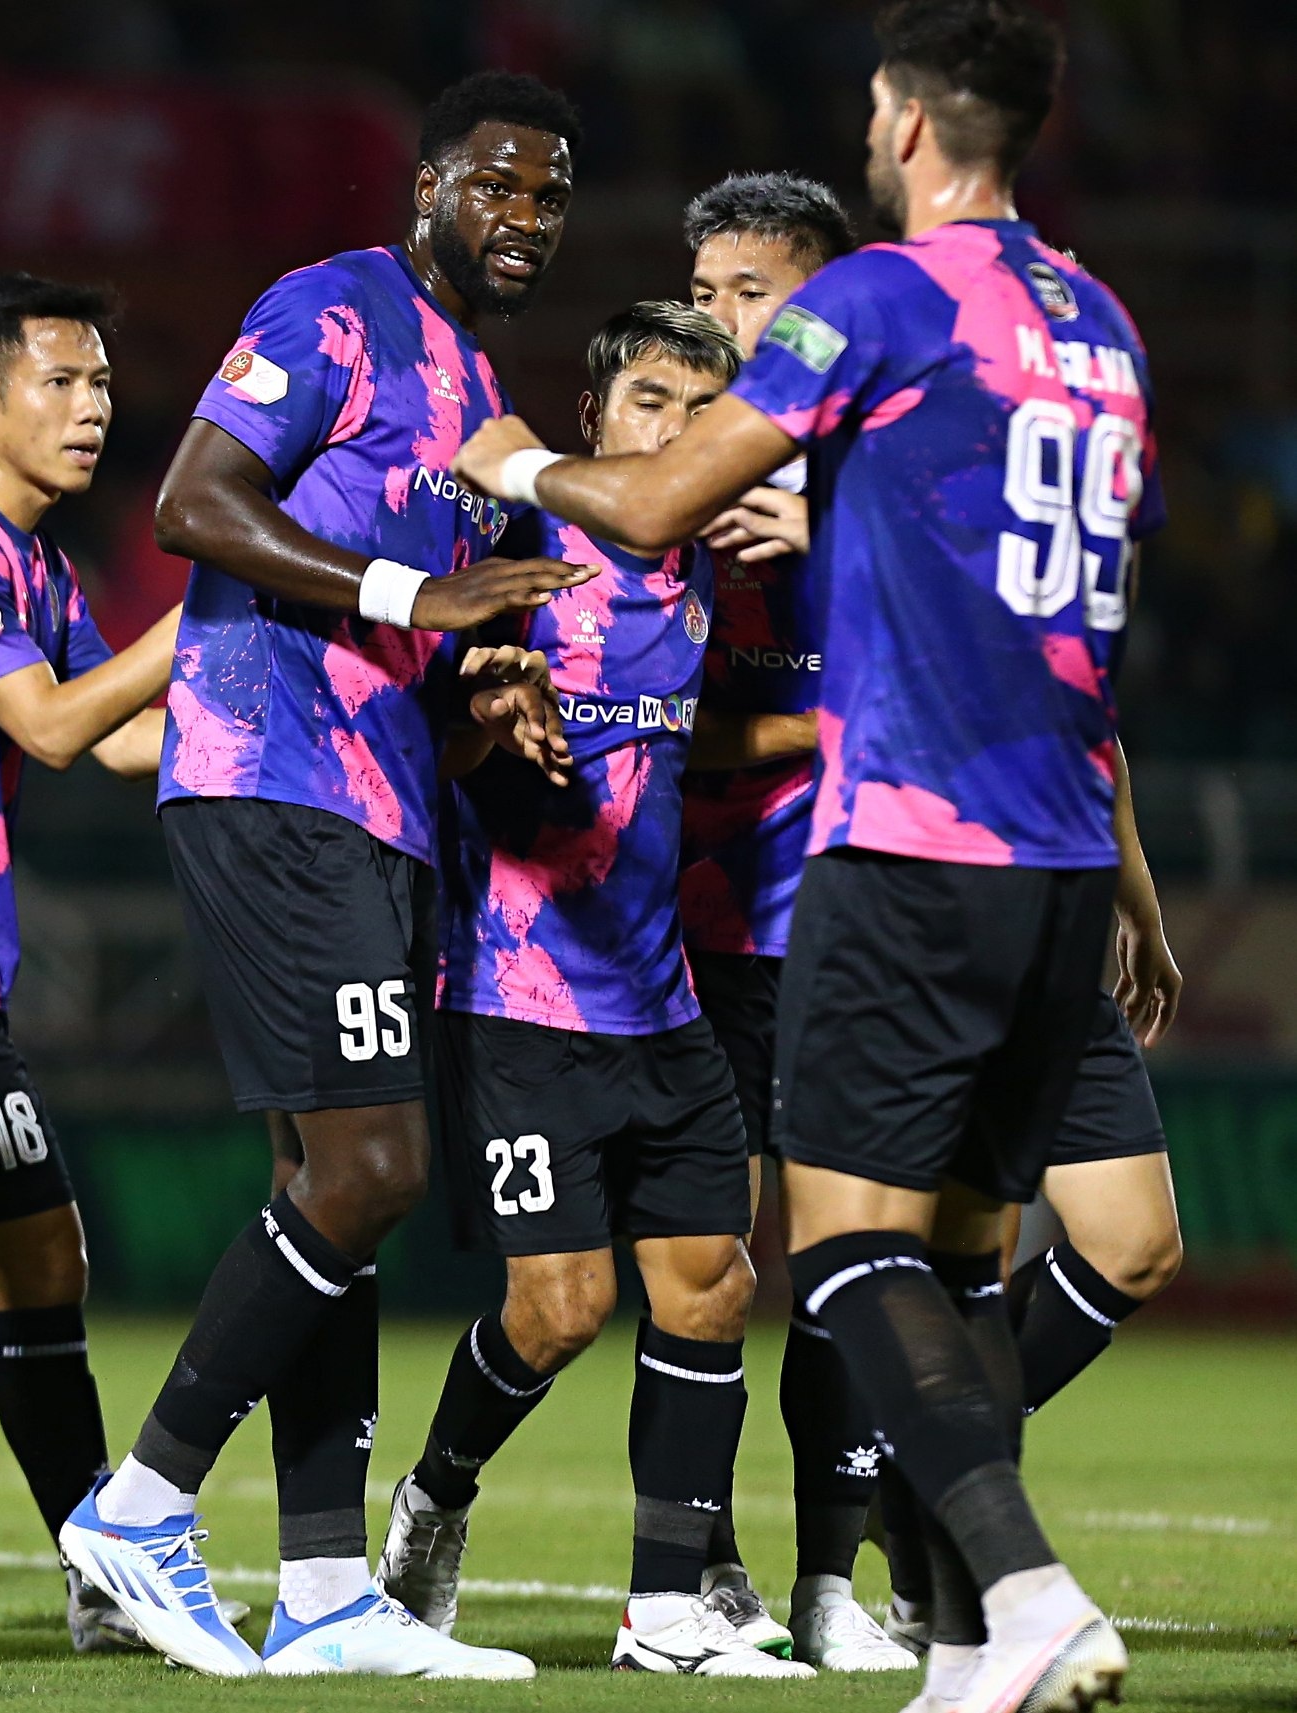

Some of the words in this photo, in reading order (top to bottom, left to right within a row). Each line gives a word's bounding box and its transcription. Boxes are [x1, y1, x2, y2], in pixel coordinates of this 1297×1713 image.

[1015, 324, 1056, 379] M.
[433, 387, 460, 403] KELME
[996, 398, 1143, 632] 99
[720, 581, 762, 590] KELME
[572, 634, 606, 644] KELME
[559, 694, 699, 732] NovaWOR
[335, 979, 411, 1062] 95
[485, 1133, 555, 1216] 23
